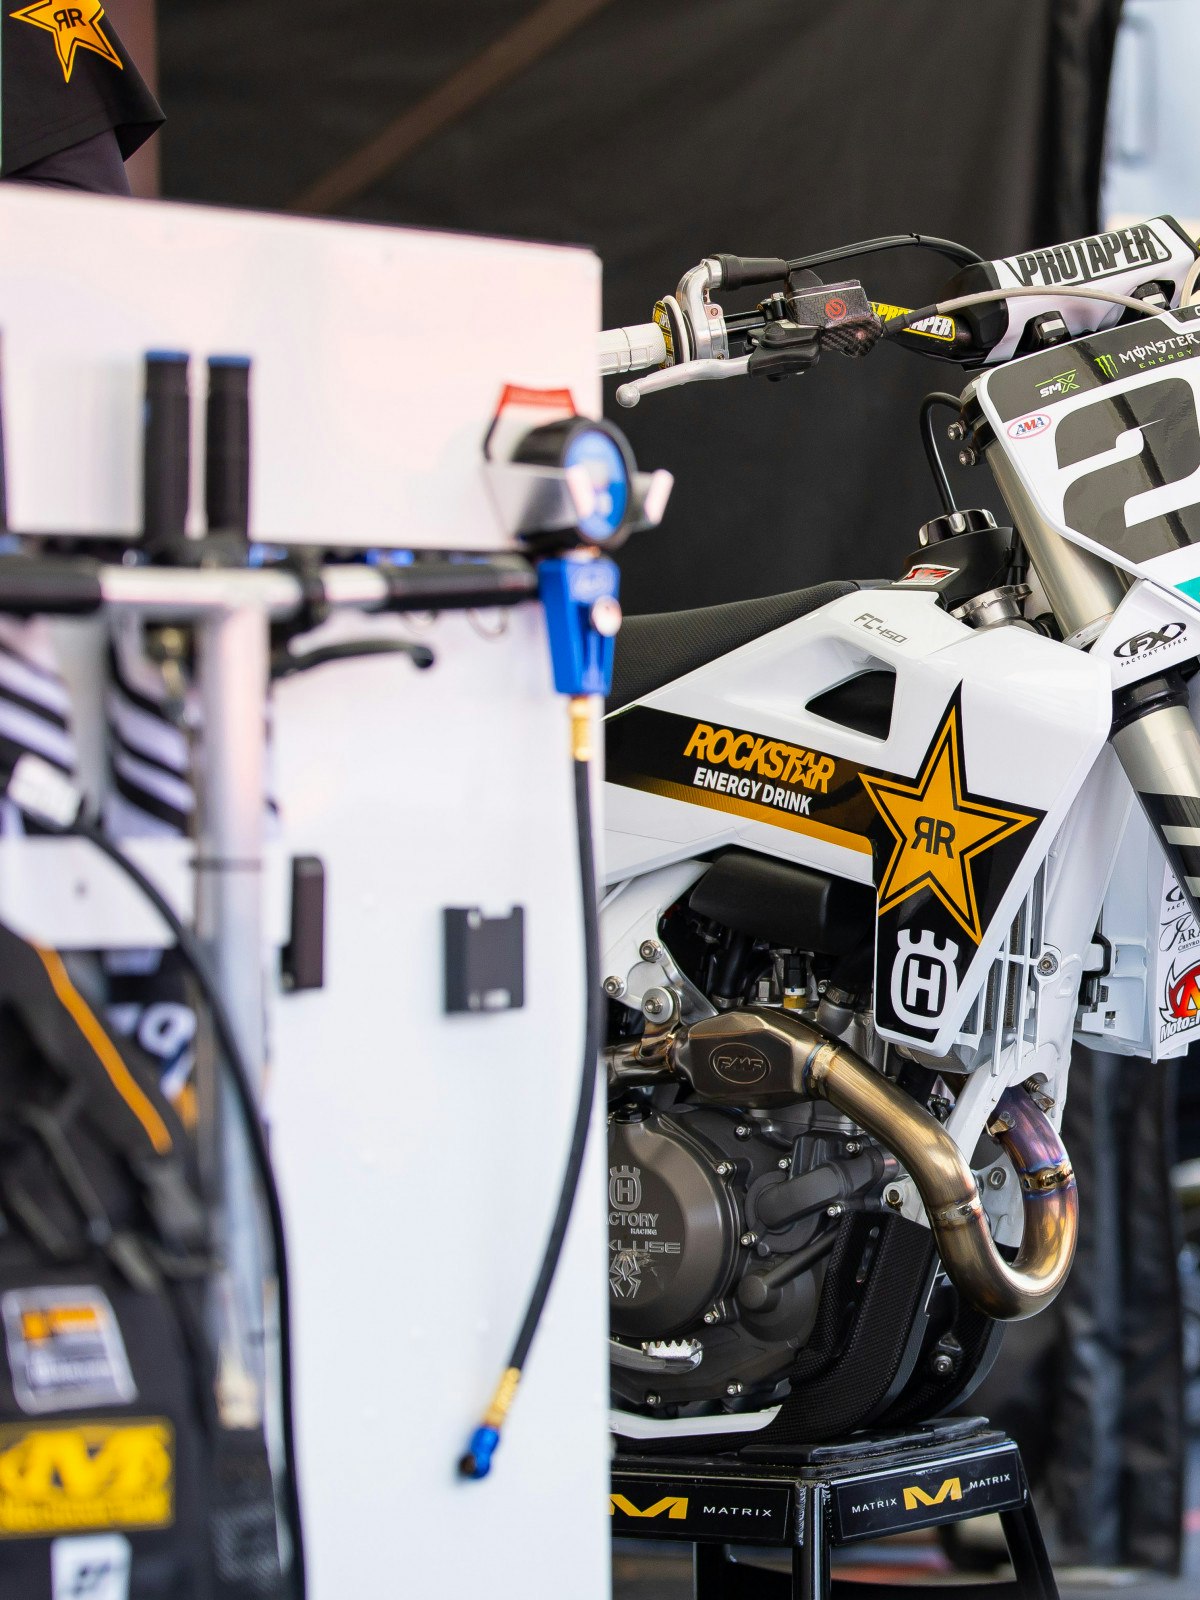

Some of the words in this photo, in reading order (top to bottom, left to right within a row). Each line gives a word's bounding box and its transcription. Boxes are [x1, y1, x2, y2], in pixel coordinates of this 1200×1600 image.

[1016, 226, 1160, 286] PROTAPER
[1118, 332, 1200, 364] MONSTER
[1138, 349, 1193, 368] ENERGY
[1039, 369, 1081, 397] SMX
[1015, 417, 1045, 435] AMA
[1120, 647, 1159, 668] FACTORY
[1162, 636, 1188, 651] EFFEX
[683, 723, 836, 794] ROCKSTAR
[692, 767, 762, 800] ENERGY
[761, 782, 812, 816] DRINK
[607, 1211, 659, 1227] CTORY
[630, 1228, 658, 1236] RACING
[608, 1240, 681, 1254] KLUSE
[851, 1497, 898, 1515] MATRIX
[969, 1473, 1011, 1490] MATRIX
[703, 1505, 773, 1518] MATRIX
